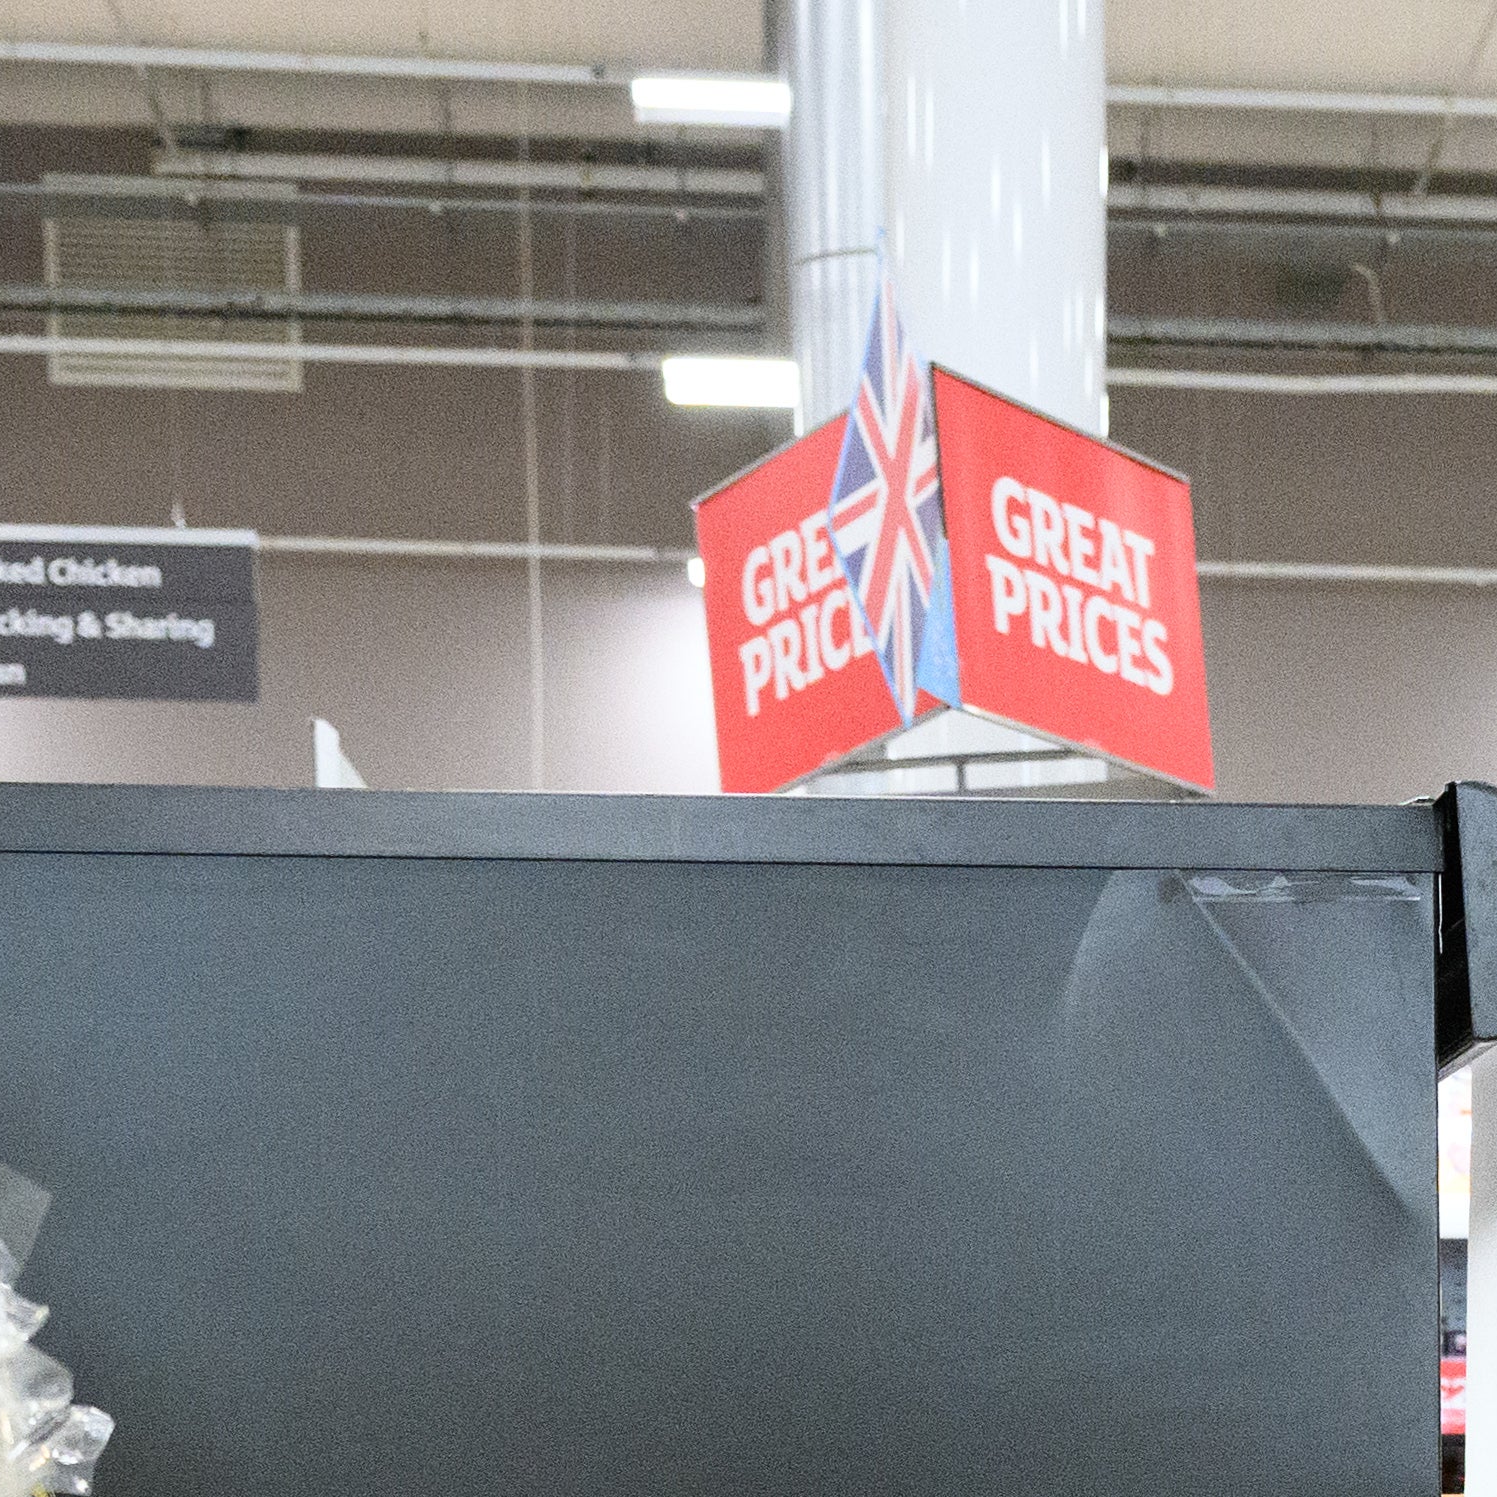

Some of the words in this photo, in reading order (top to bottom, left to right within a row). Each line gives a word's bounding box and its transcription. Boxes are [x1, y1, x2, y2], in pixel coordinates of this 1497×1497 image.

[48, 557, 161, 587] Chicken
[741, 509, 845, 627] GRE
[990, 476, 1156, 608] GREAT
[77, 610, 103, 639] &
[104, 611, 215, 648] Sharing
[985, 553, 1174, 696] PRICES
